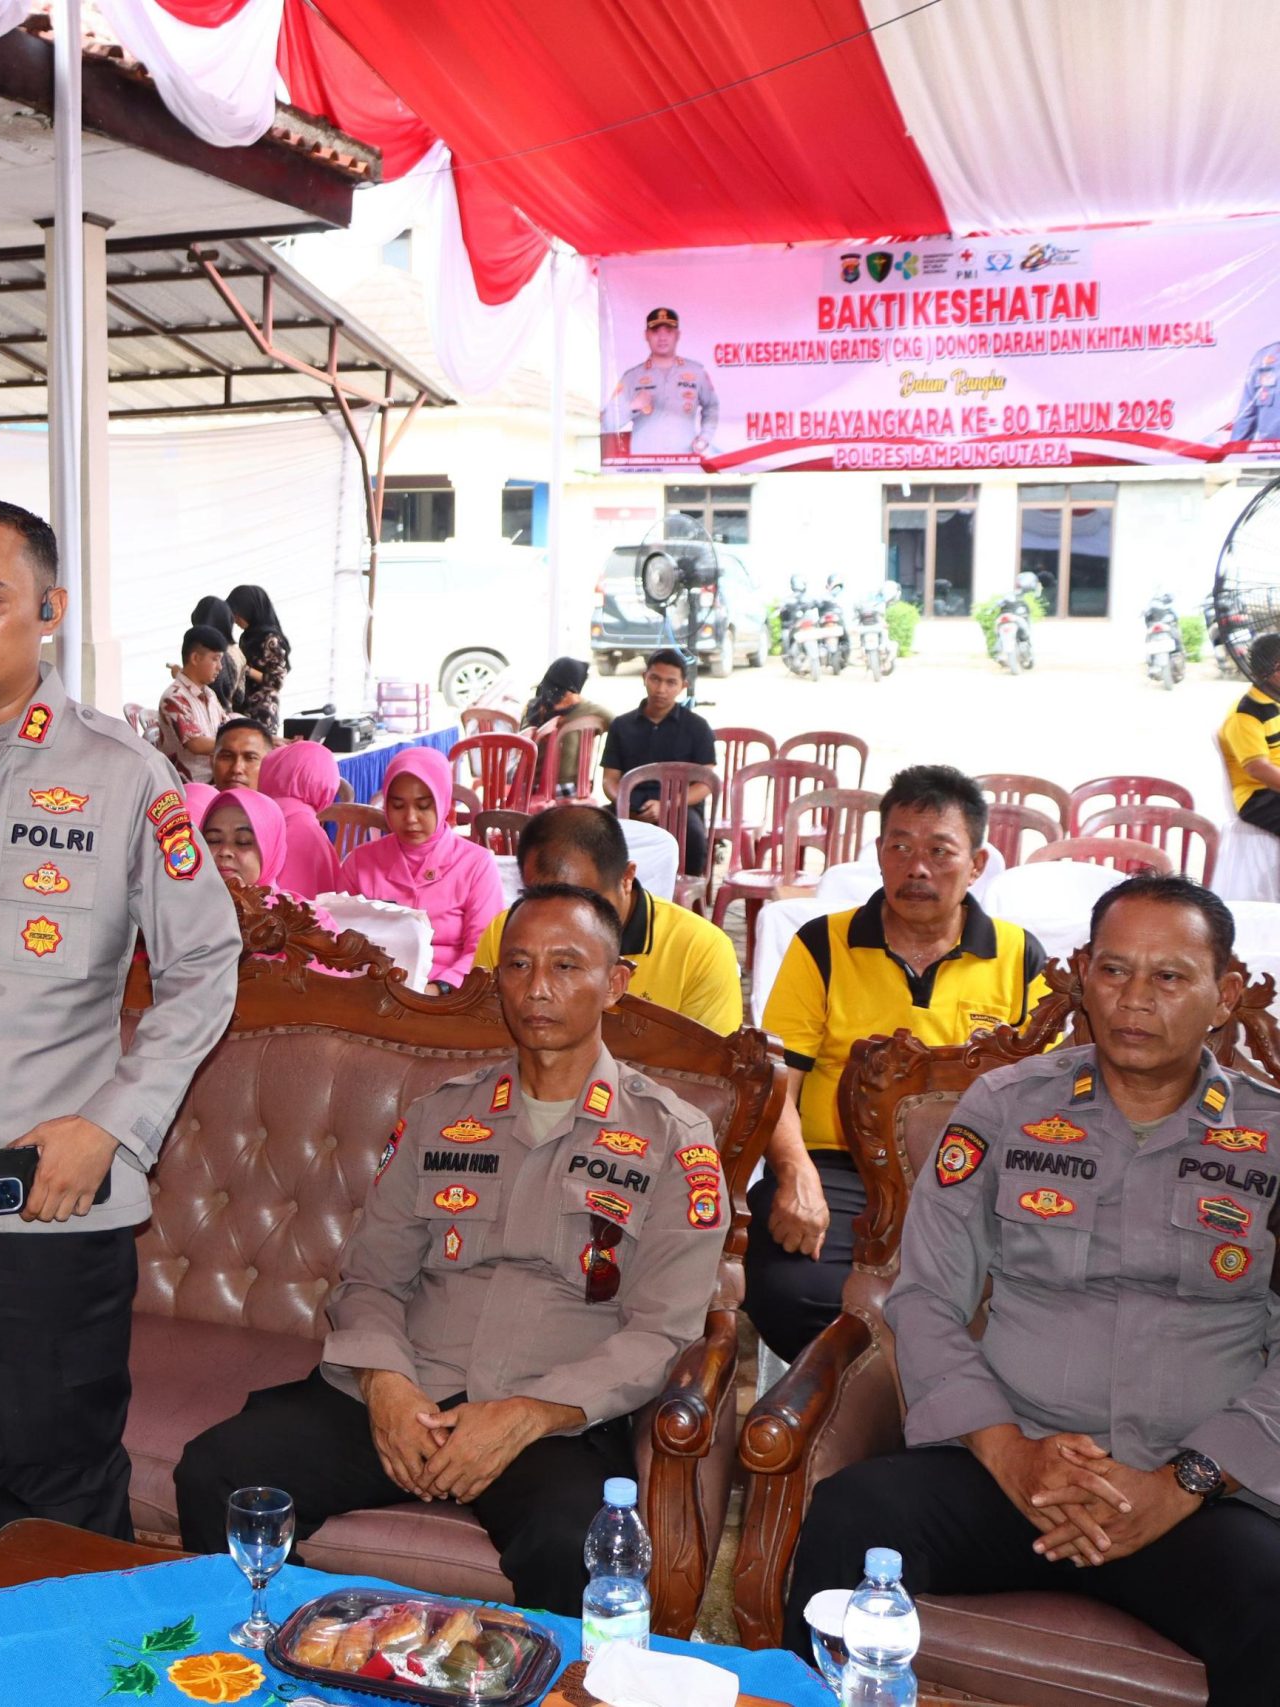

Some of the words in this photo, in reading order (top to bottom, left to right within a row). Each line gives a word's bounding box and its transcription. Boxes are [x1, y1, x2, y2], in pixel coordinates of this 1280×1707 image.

[818, 292, 905, 331] BAKTI
[912, 281, 1099, 326] KESEHATAN
[714, 343, 742, 365] CEK
[745, 341, 826, 364] KESEHATAN
[830, 338, 882, 361] GRATIS
[894, 336, 923, 357] CKG
[936, 333, 988, 358] DONOR
[993, 330, 1045, 355] DARAH
[1050, 328, 1083, 351] DAN
[1087, 325, 1143, 350] KHITAN
[1148, 321, 1215, 346] MASSAL
[900, 370, 947, 398] Dalam
[950, 368, 1006, 399] Rangka
[746, 411, 794, 439] HARI
[800, 406, 954, 438] BHAYANGKARA
[961, 406, 998, 434] KE-
[1002, 405, 1031, 434] 80
[1036, 401, 1111, 432] TAHUN
[1116, 398, 1175, 430] 2026
[835, 446, 907, 468] POLRES
[910, 443, 1004, 467] LAMPUNG
[1005, 440, 1071, 465] UTARA
[10, 823, 94, 852] POLRI
[568, 1155, 651, 1194] POLRI
[1005, 1148, 1097, 1180] IRWANTO
[1178, 1157, 1277, 1198] POLRI
